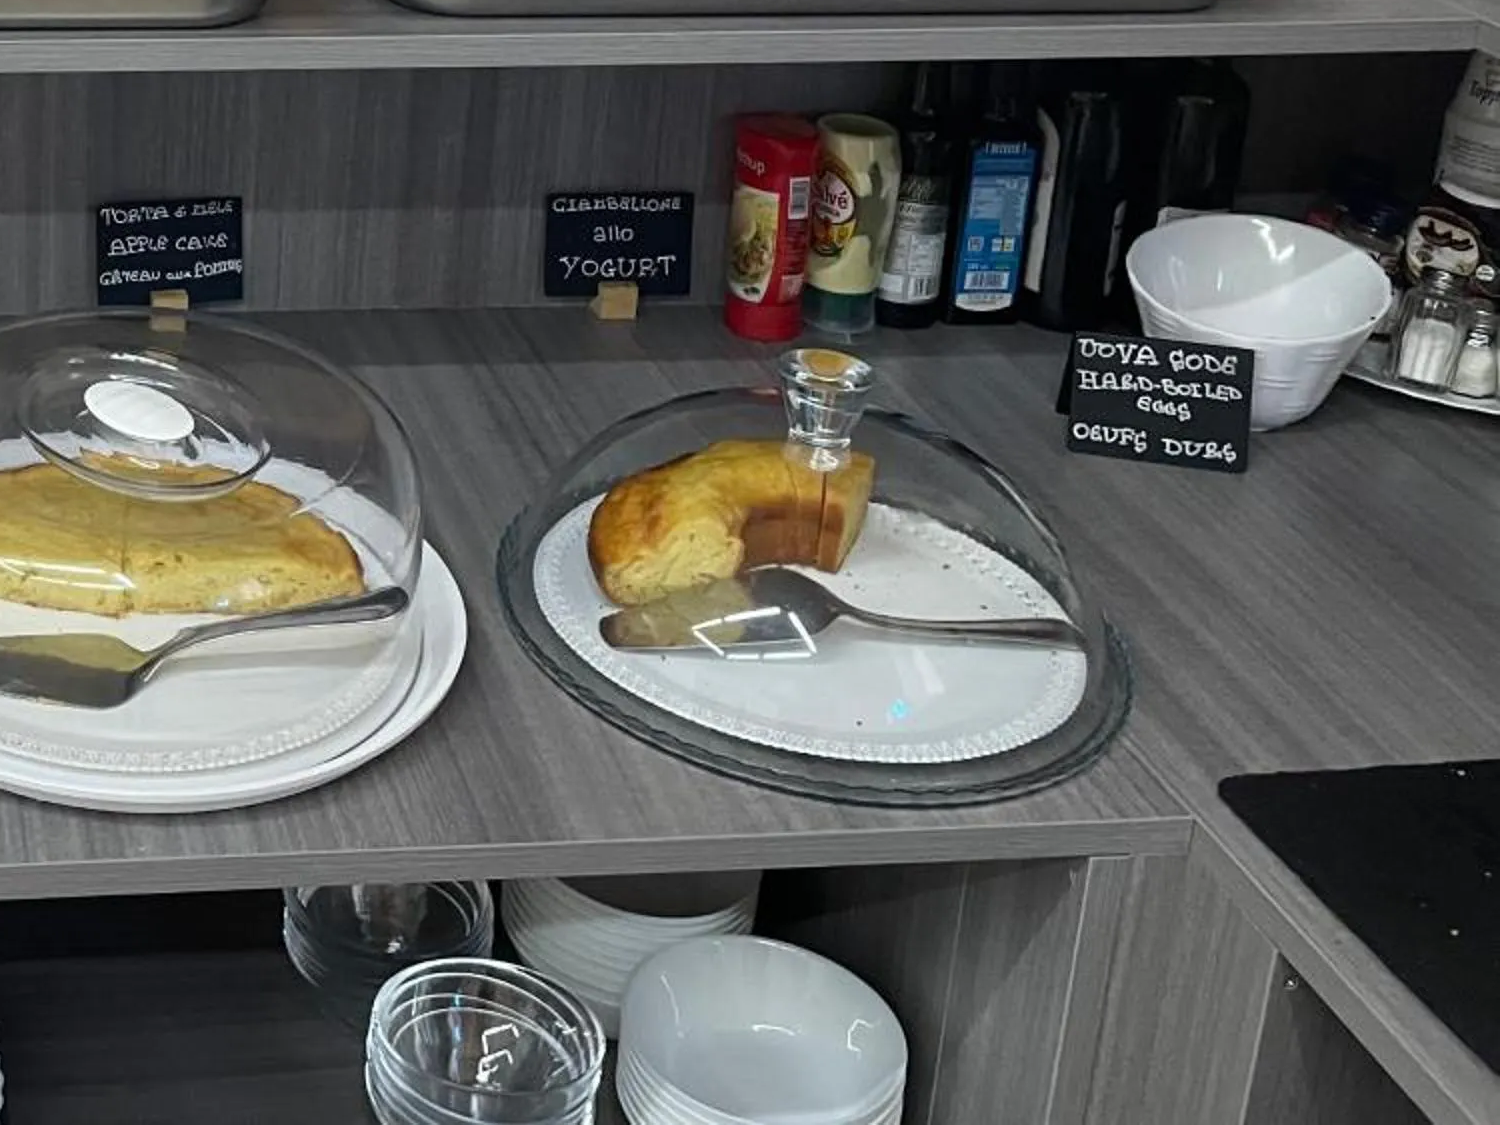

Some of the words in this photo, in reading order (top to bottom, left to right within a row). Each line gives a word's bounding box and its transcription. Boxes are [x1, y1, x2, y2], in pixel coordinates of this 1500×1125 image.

[99, 205, 170, 225] TORTA
[107, 235, 169, 256] APPLE
[175, 232, 229, 250] CAKE
[593, 226, 634, 242] allo
[559, 255, 677, 279] YOGURT
[1076, 338, 1160, 366] UOVA
[1169, 349, 1238, 376] SODE
[1076, 368, 1243, 401] HARD-BOILED
[1137, 395, 1192, 422] EGGS
[1073, 422, 1148, 453] OEUFS
[1161, 438, 1237, 463] DURS
